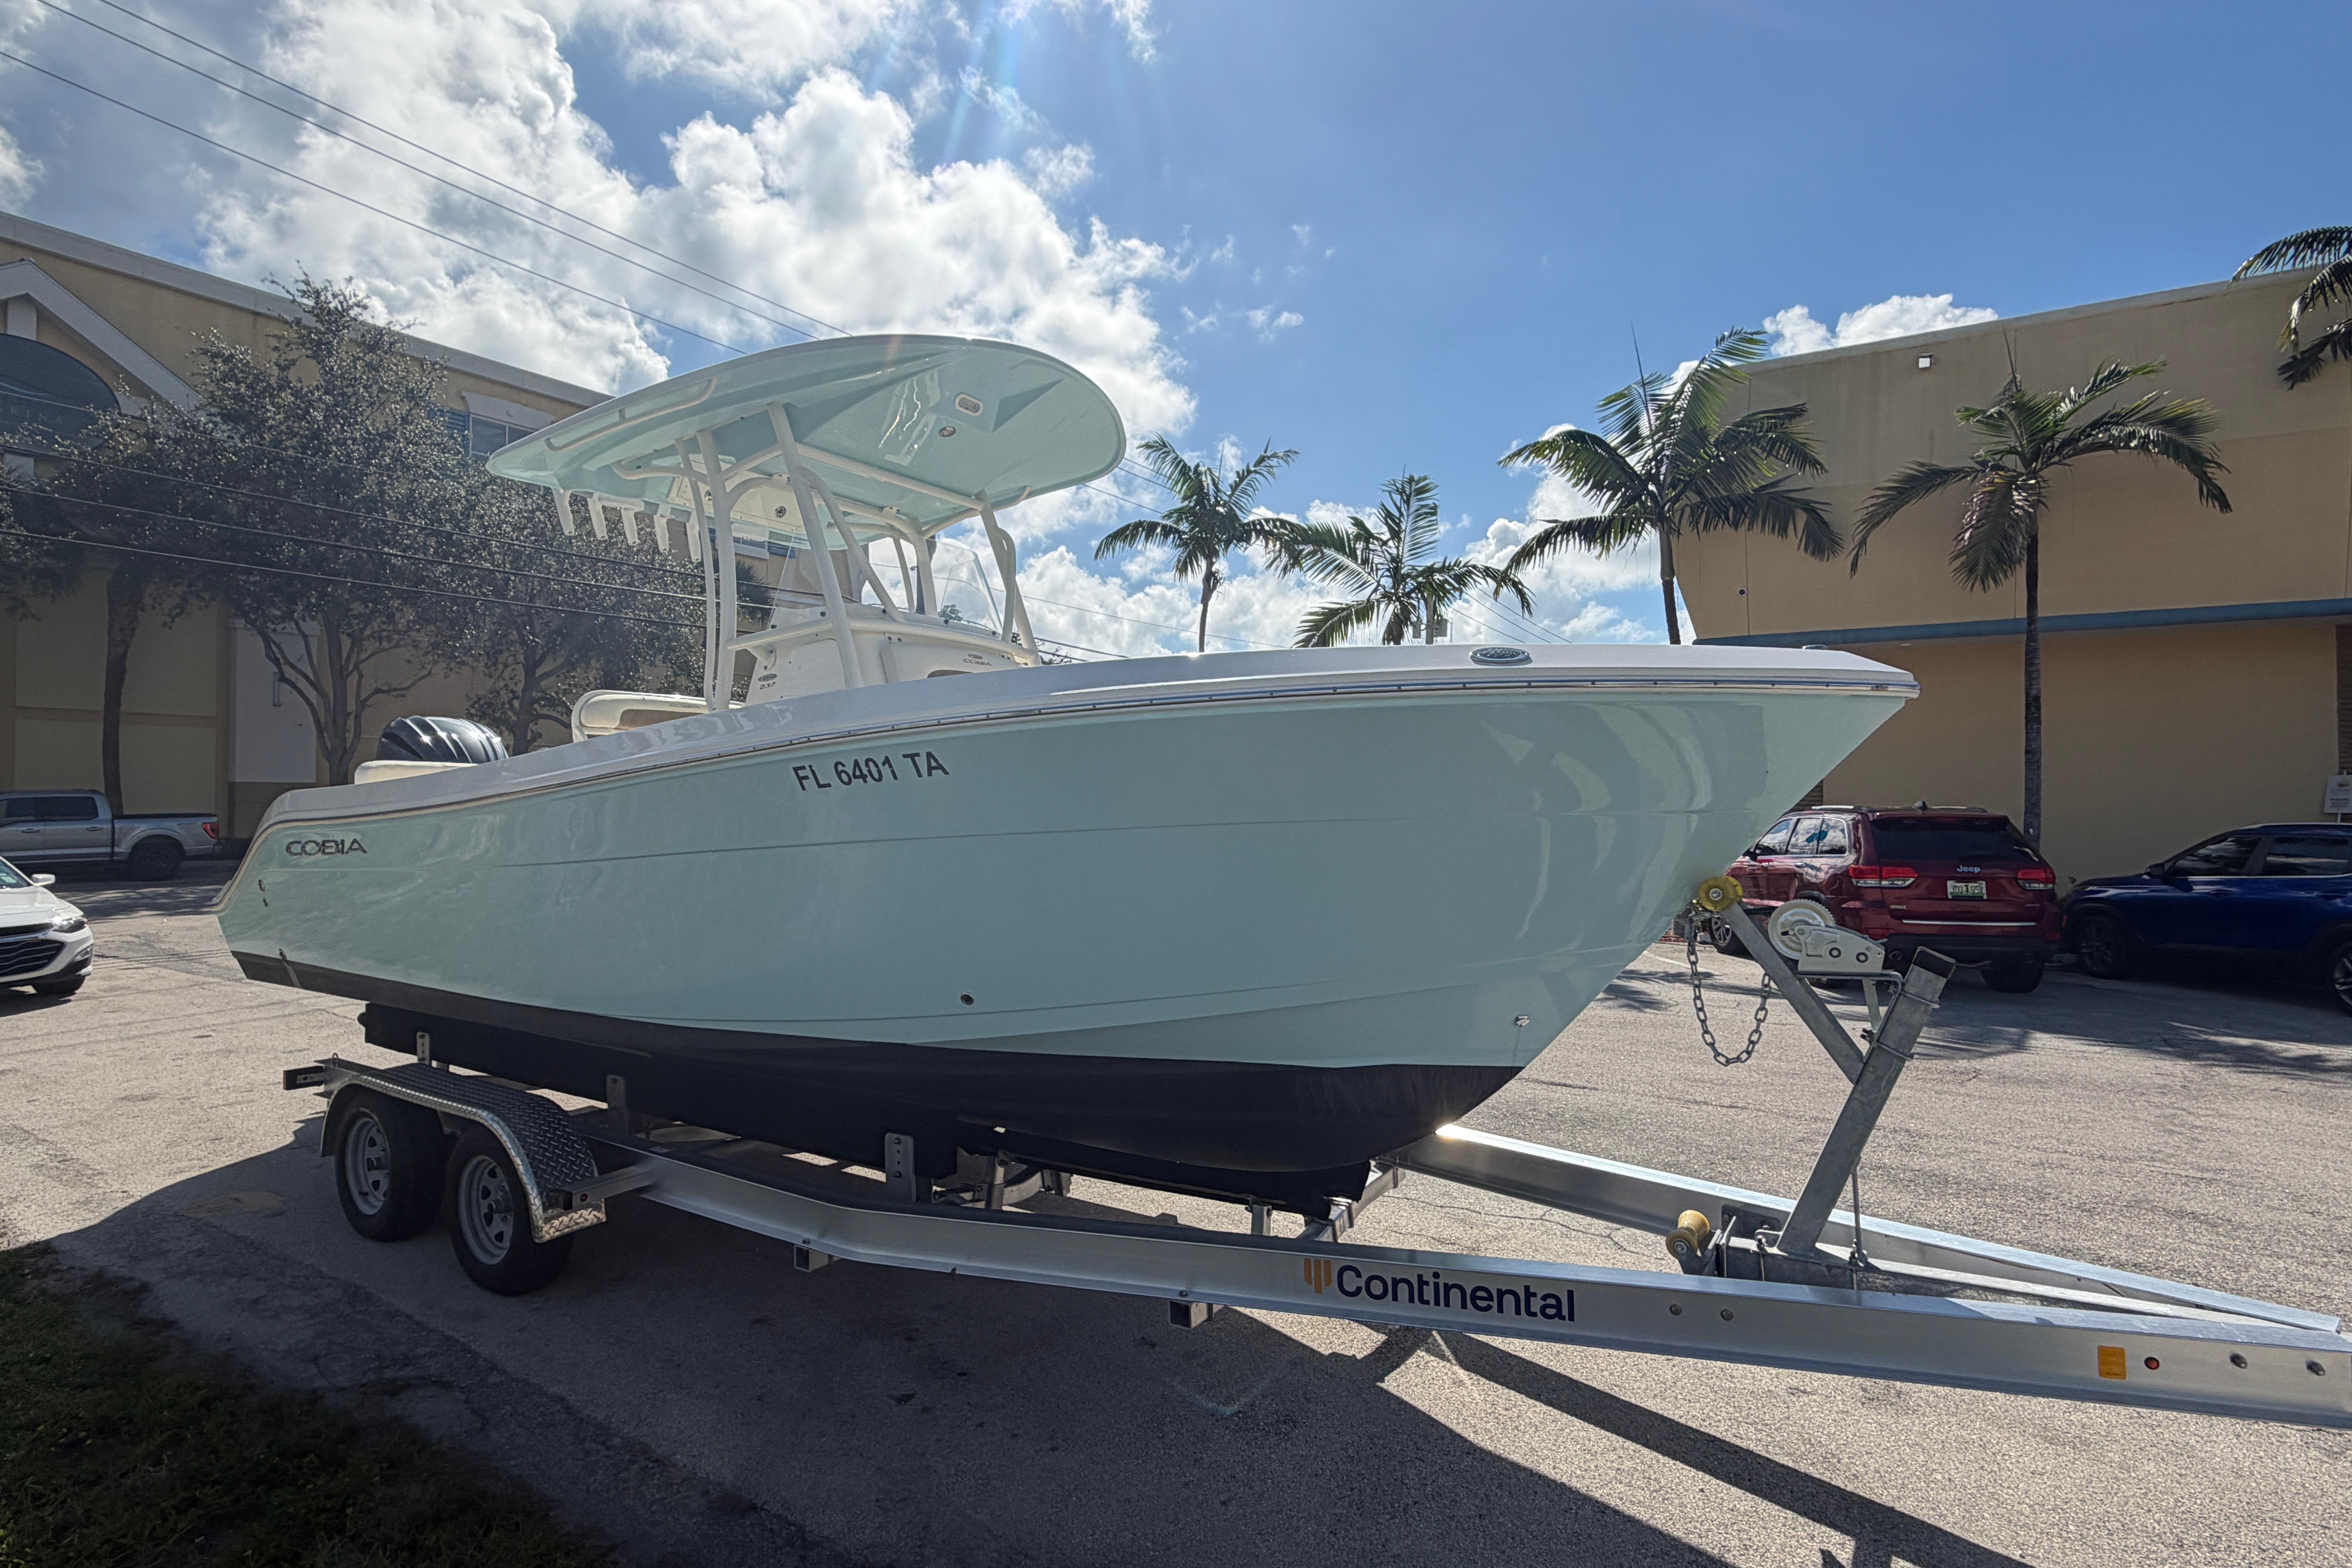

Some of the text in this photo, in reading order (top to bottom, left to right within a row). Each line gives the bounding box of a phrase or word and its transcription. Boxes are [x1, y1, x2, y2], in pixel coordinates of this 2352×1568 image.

[792, 751, 950, 791] FL 6401 TA
[286, 838, 367, 856] COBIA
[1957, 865, 1981, 873] Jeep
[1337, 1265, 1575, 1322] Continental
